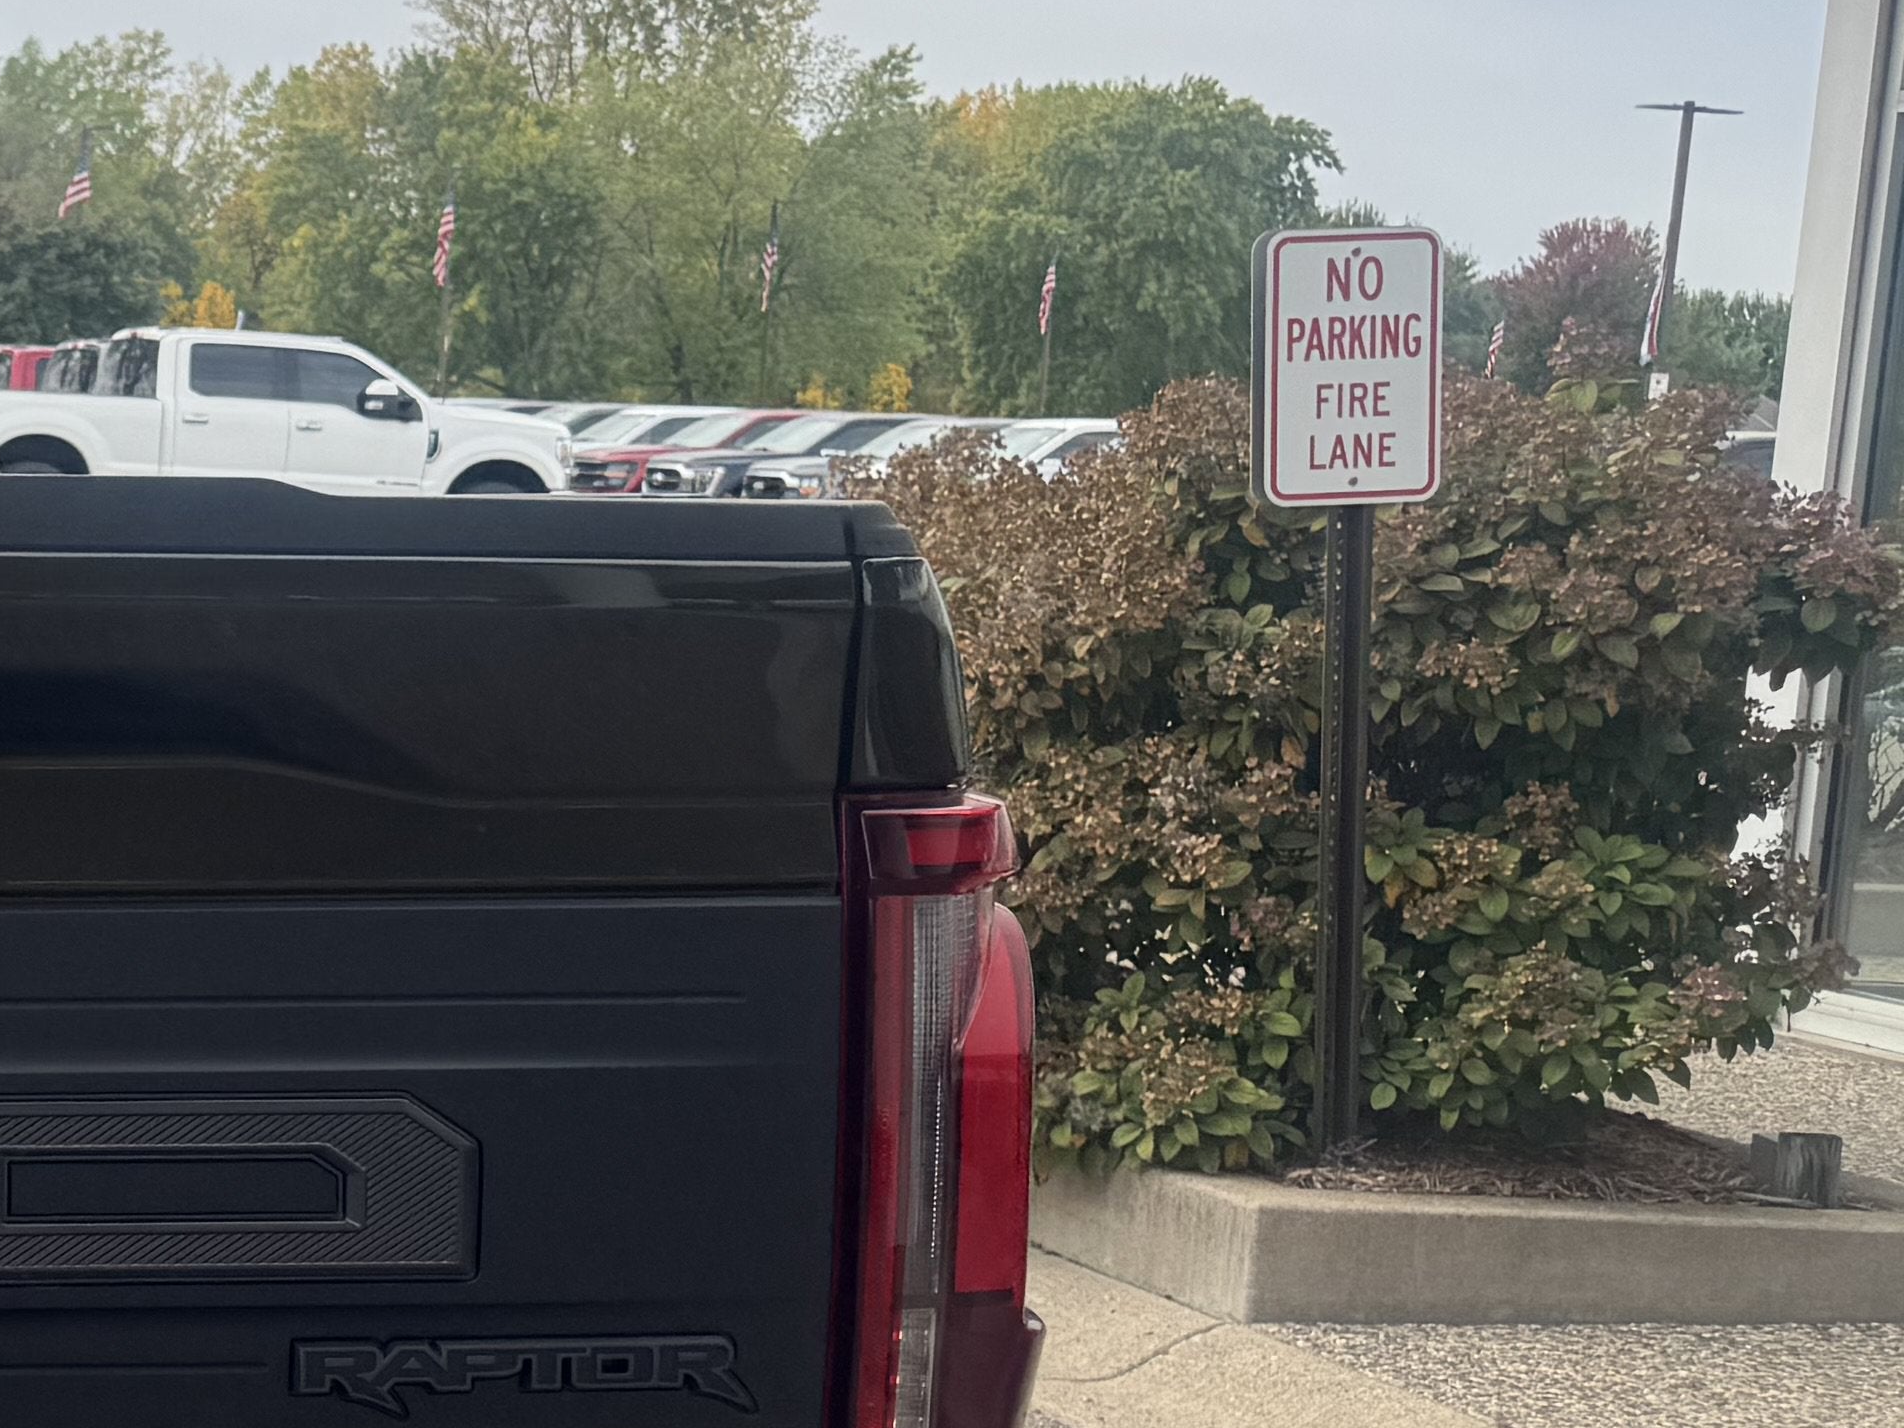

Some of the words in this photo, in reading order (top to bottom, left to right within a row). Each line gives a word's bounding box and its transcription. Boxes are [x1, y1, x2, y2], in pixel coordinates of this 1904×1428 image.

[1326, 255, 1384, 303] NO
[1286, 312, 1422, 363] PARKING
[1316, 381, 1391, 419] FIRE
[1309, 432, 1396, 470] LANE
[296, 1334, 758, 1418] RAPTOR
